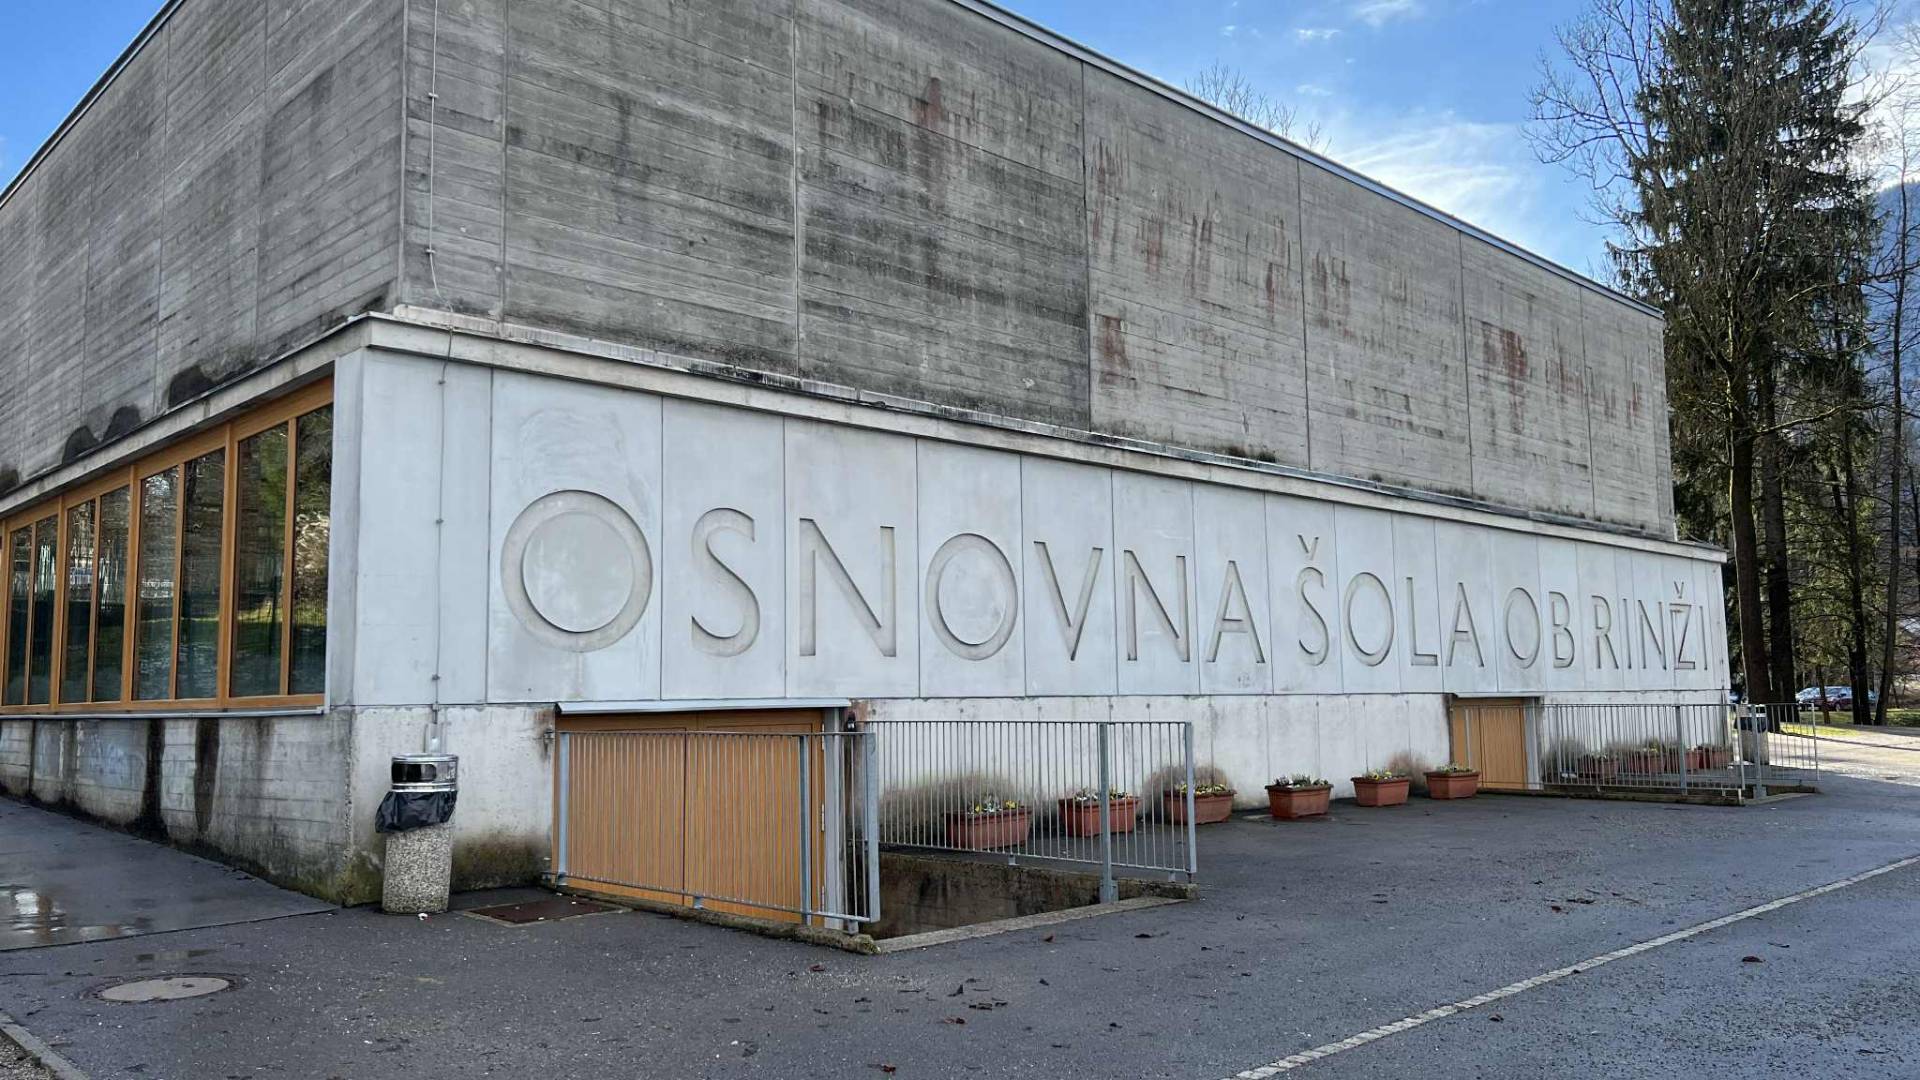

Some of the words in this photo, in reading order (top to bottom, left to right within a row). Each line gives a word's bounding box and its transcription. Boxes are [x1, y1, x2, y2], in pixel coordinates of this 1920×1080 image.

[501, 489, 1265, 663] OSNOVNA
[1298, 534, 1485, 667] ŠOLA
[1505, 587, 1575, 669] OB
[1592, 581, 1708, 671] RINŽI
